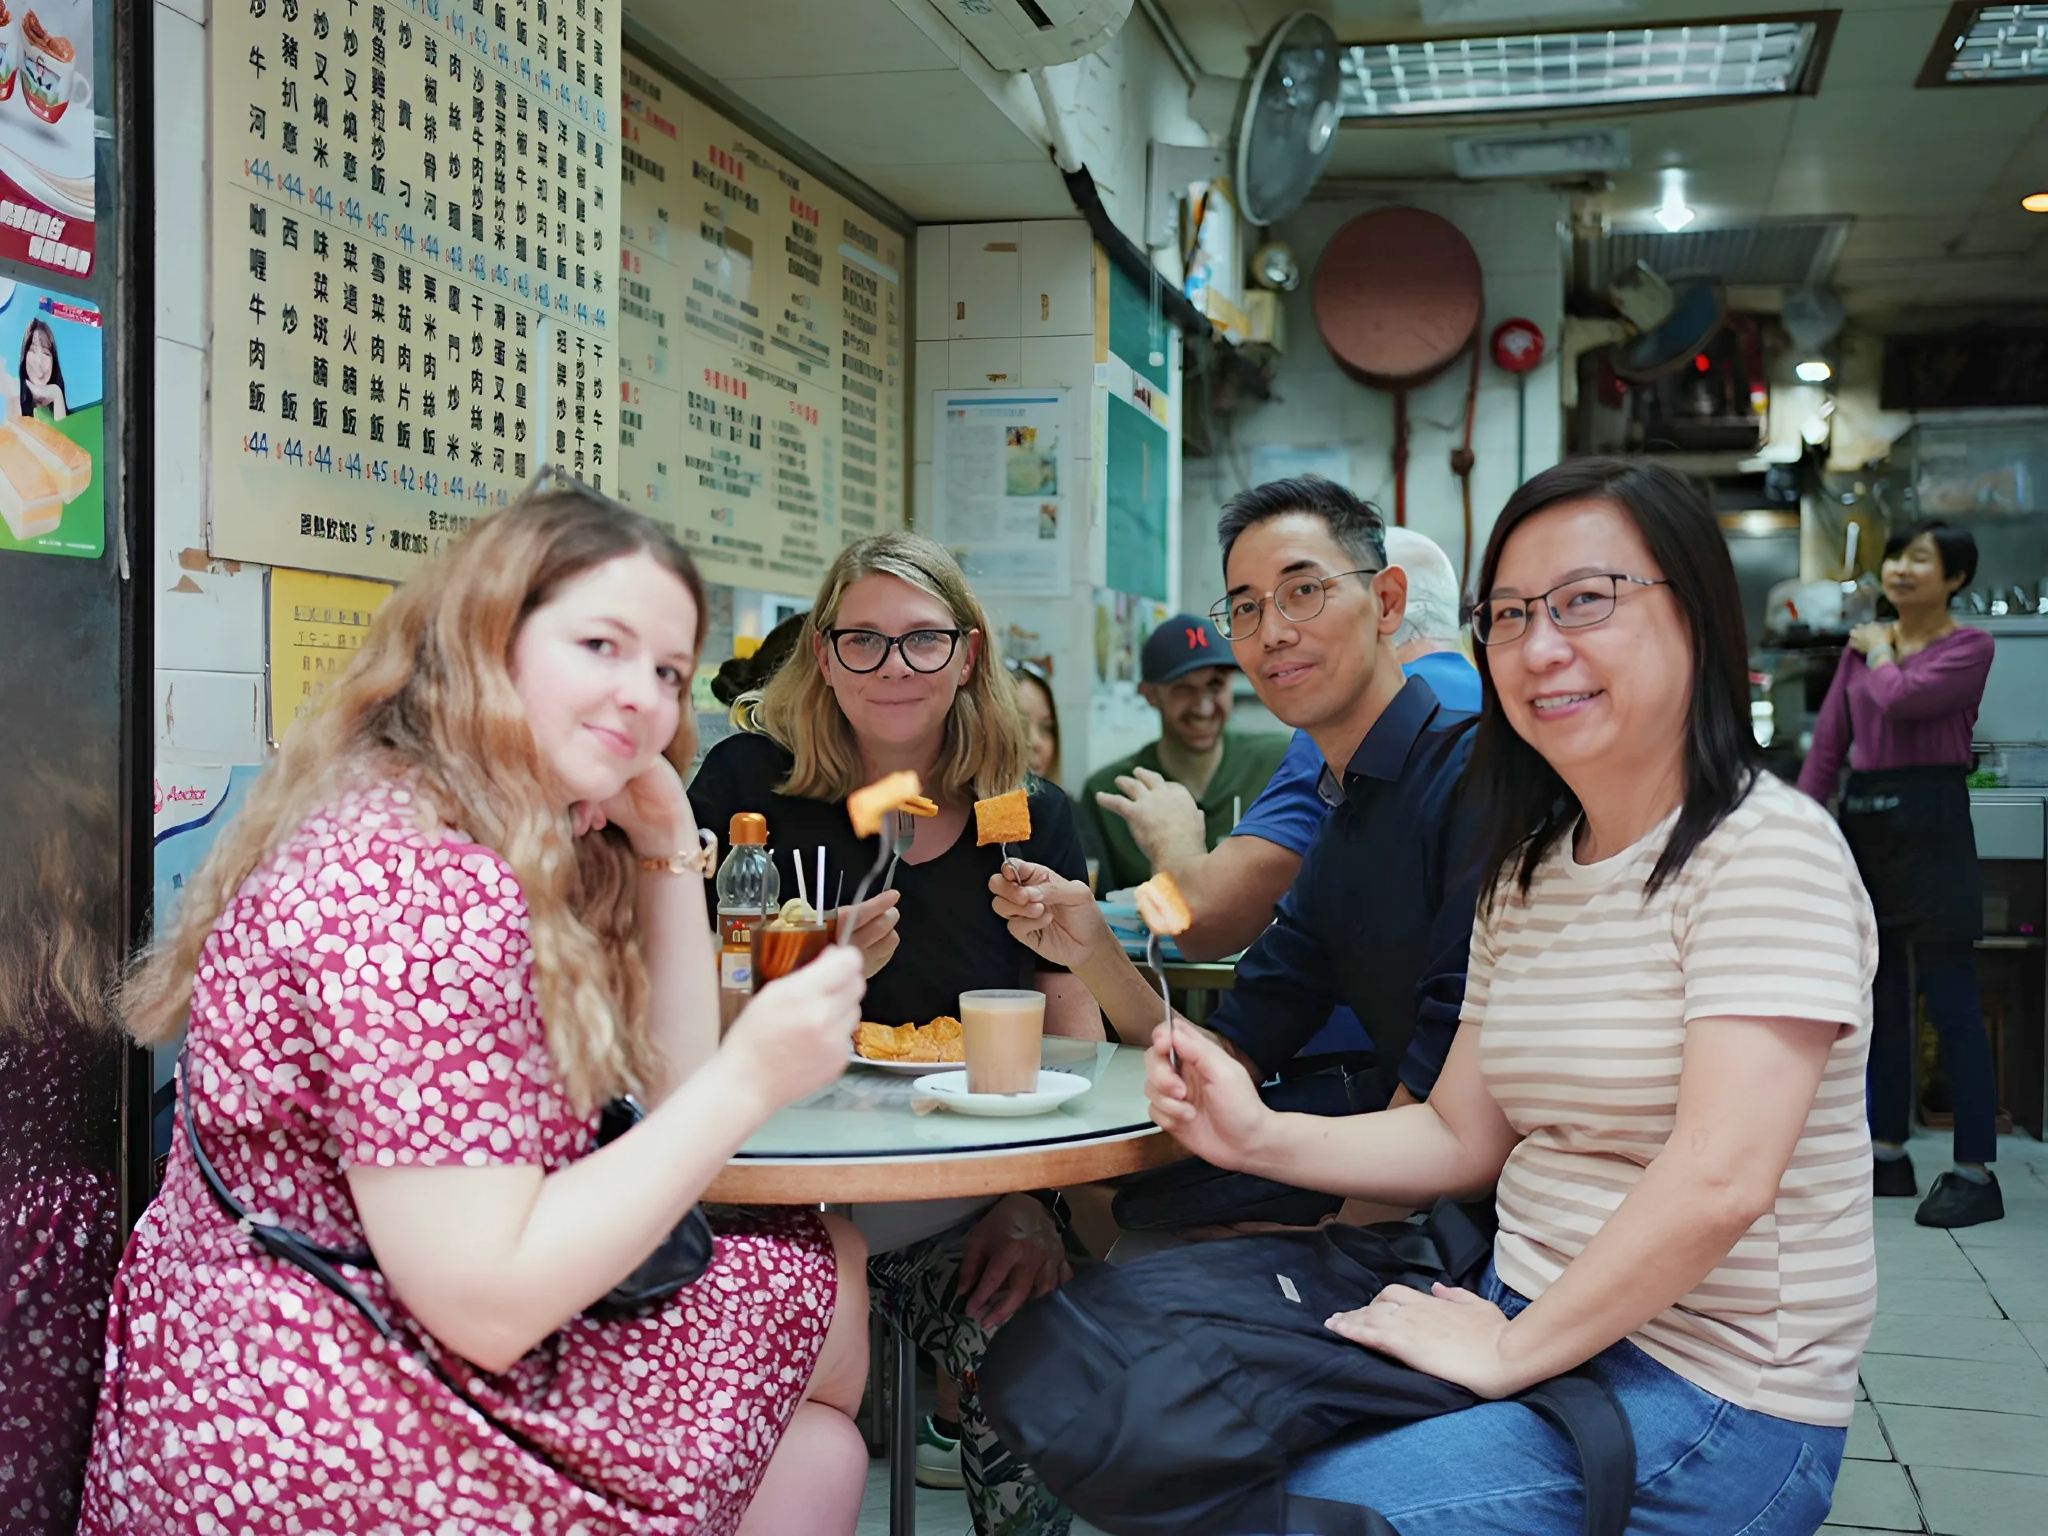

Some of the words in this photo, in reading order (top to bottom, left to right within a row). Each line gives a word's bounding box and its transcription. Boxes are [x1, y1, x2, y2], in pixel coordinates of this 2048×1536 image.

[281, 215, 298, 423] 西炒飯
[243, 431, 269, 460] $44
[276, 437, 304, 468] $44
[308, 444, 332, 474] $44
[338, 452, 362, 480] $44
[366, 460, 389, 482] $45
[393, 464, 415, 491] $42
[419, 470, 438, 496] $42
